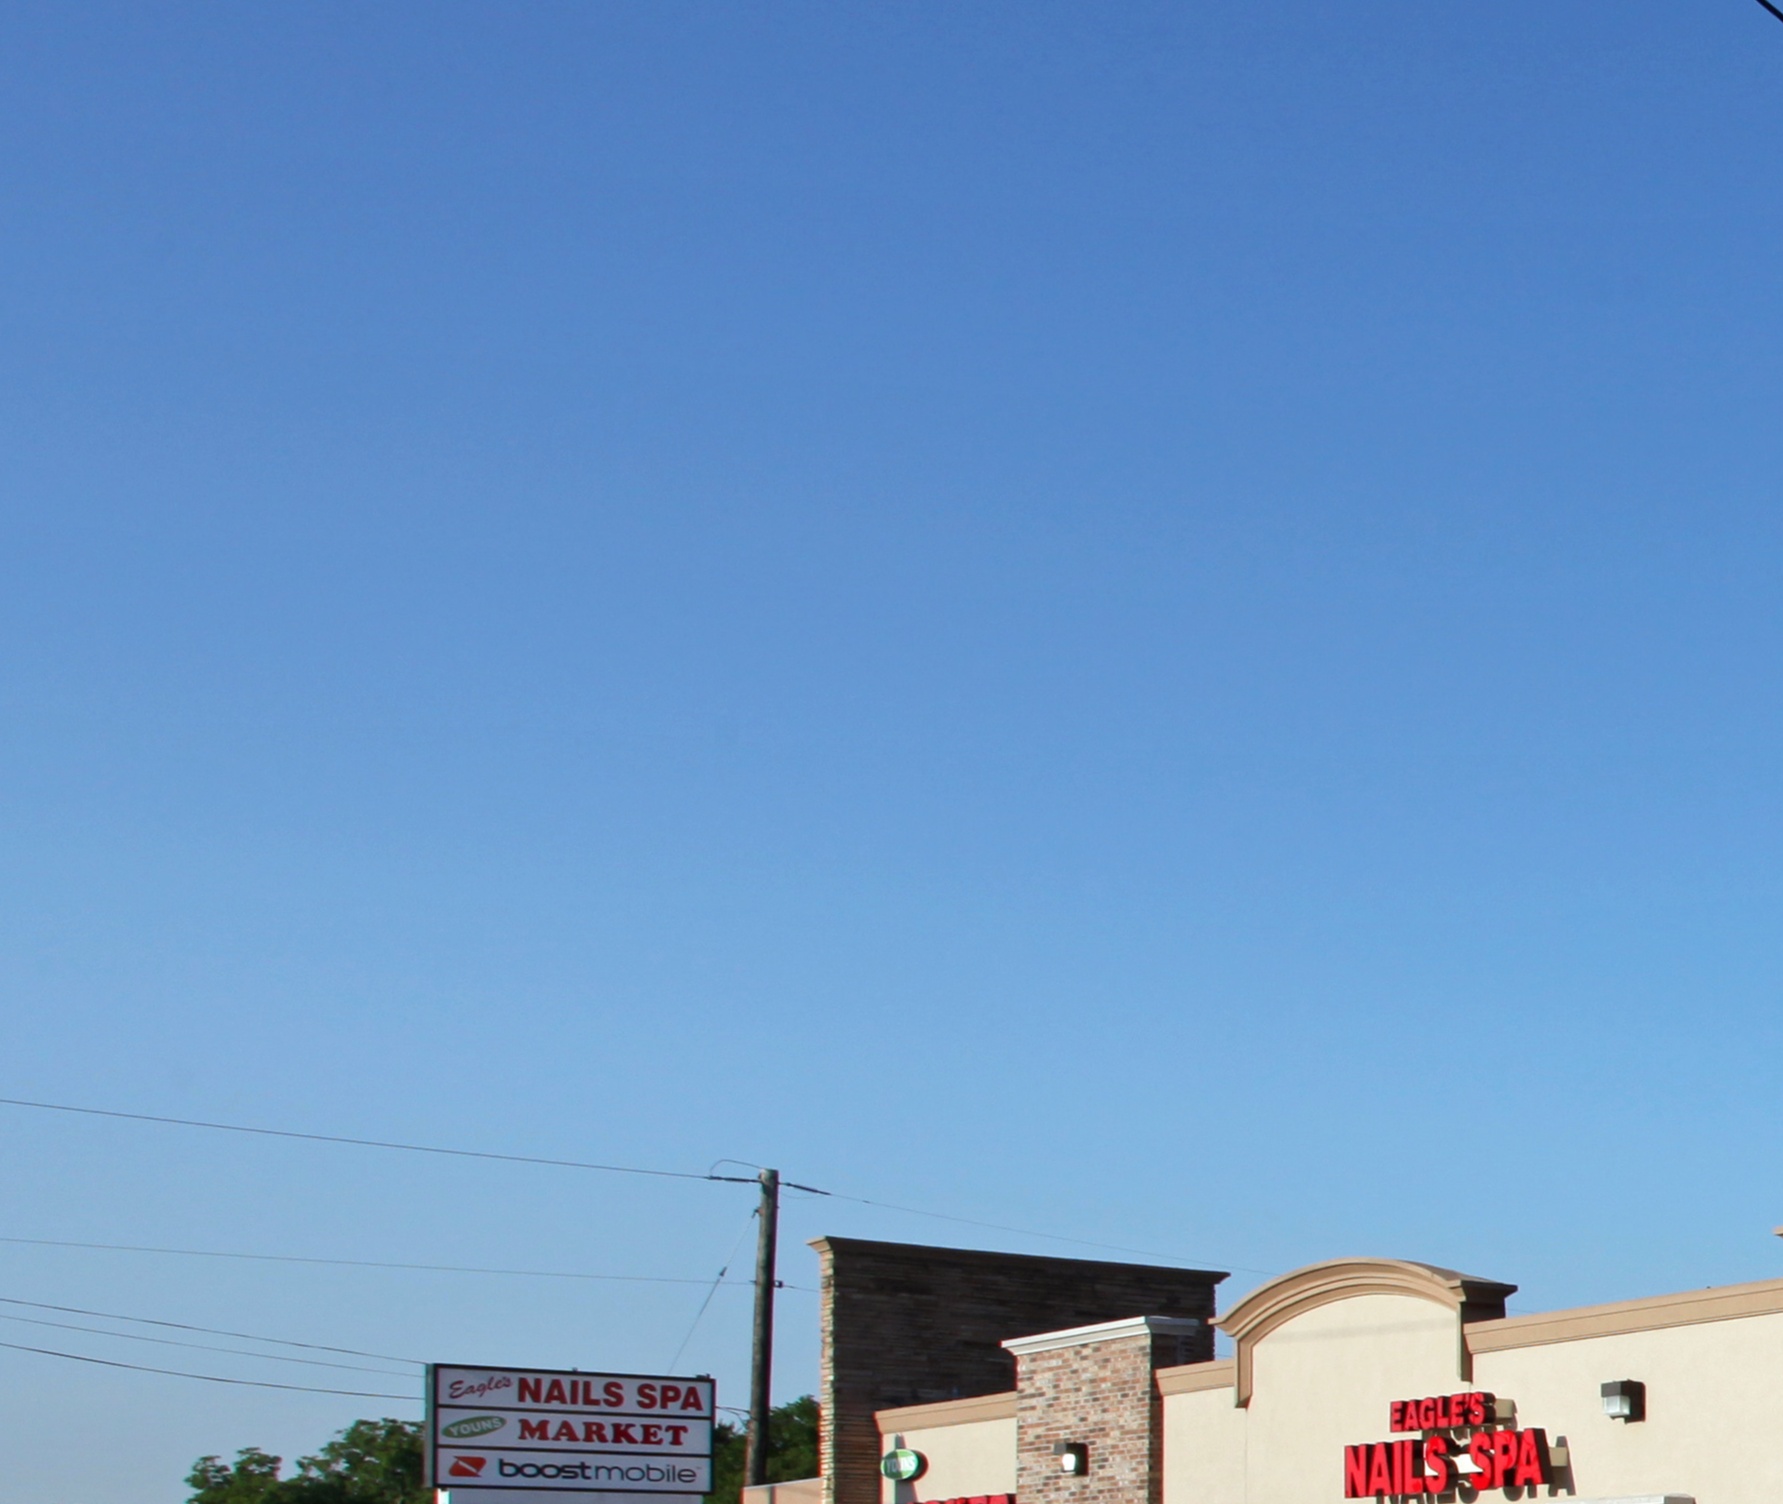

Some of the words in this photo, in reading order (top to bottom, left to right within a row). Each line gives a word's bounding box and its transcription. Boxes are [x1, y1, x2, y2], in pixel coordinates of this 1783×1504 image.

[449, 1376, 513, 1399] Eagle's
[517, 1377, 625, 1408] NAILS
[636, 1383, 704, 1411] SPA
[1390, 1391, 1487, 1432] EAGLE'S
[518, 1418, 689, 1446] MARKET
[1344, 1435, 1448, 1498] NAILS
[1469, 1428, 1545, 1491] SPA
